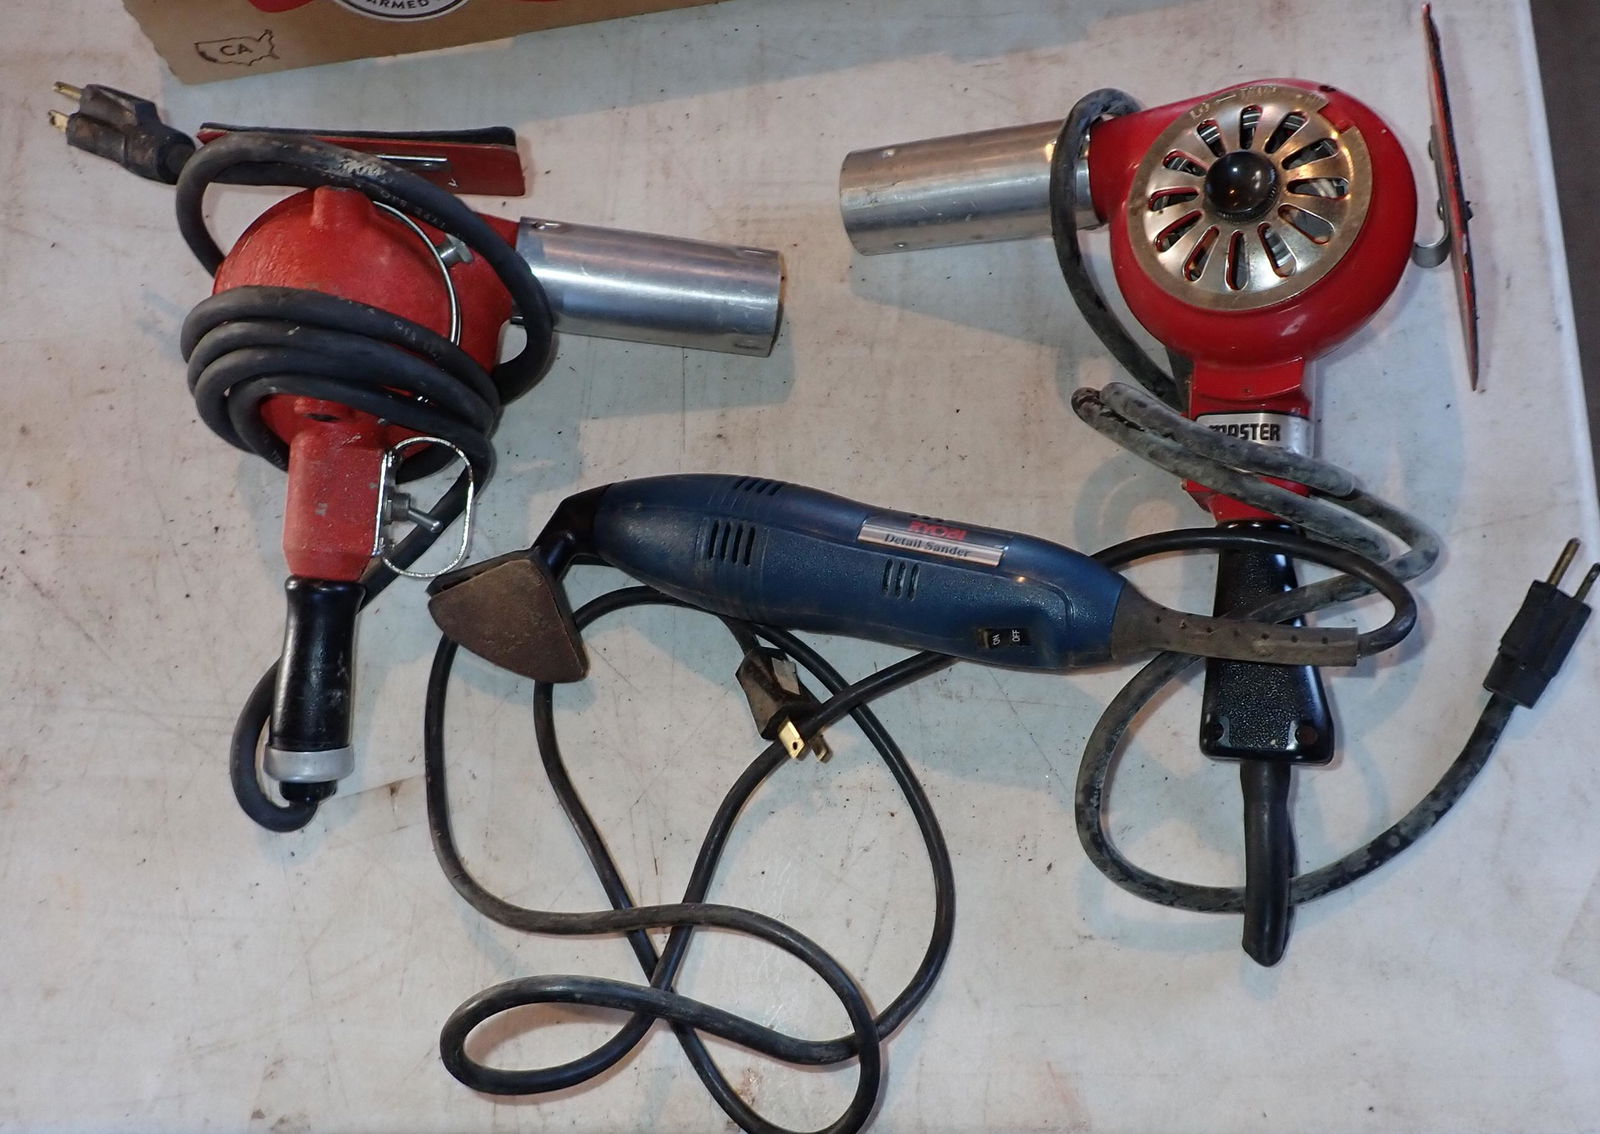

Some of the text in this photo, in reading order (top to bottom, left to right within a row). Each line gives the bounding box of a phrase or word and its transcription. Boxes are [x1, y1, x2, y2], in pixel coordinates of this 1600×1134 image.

[220, 38, 253, 55] CA
[908, 520, 967, 540] RYOBI
[884, 533, 971, 558] Detail Sander
[991, 633, 1001, 646] ON
[1009, 629, 1020, 642] OFF
